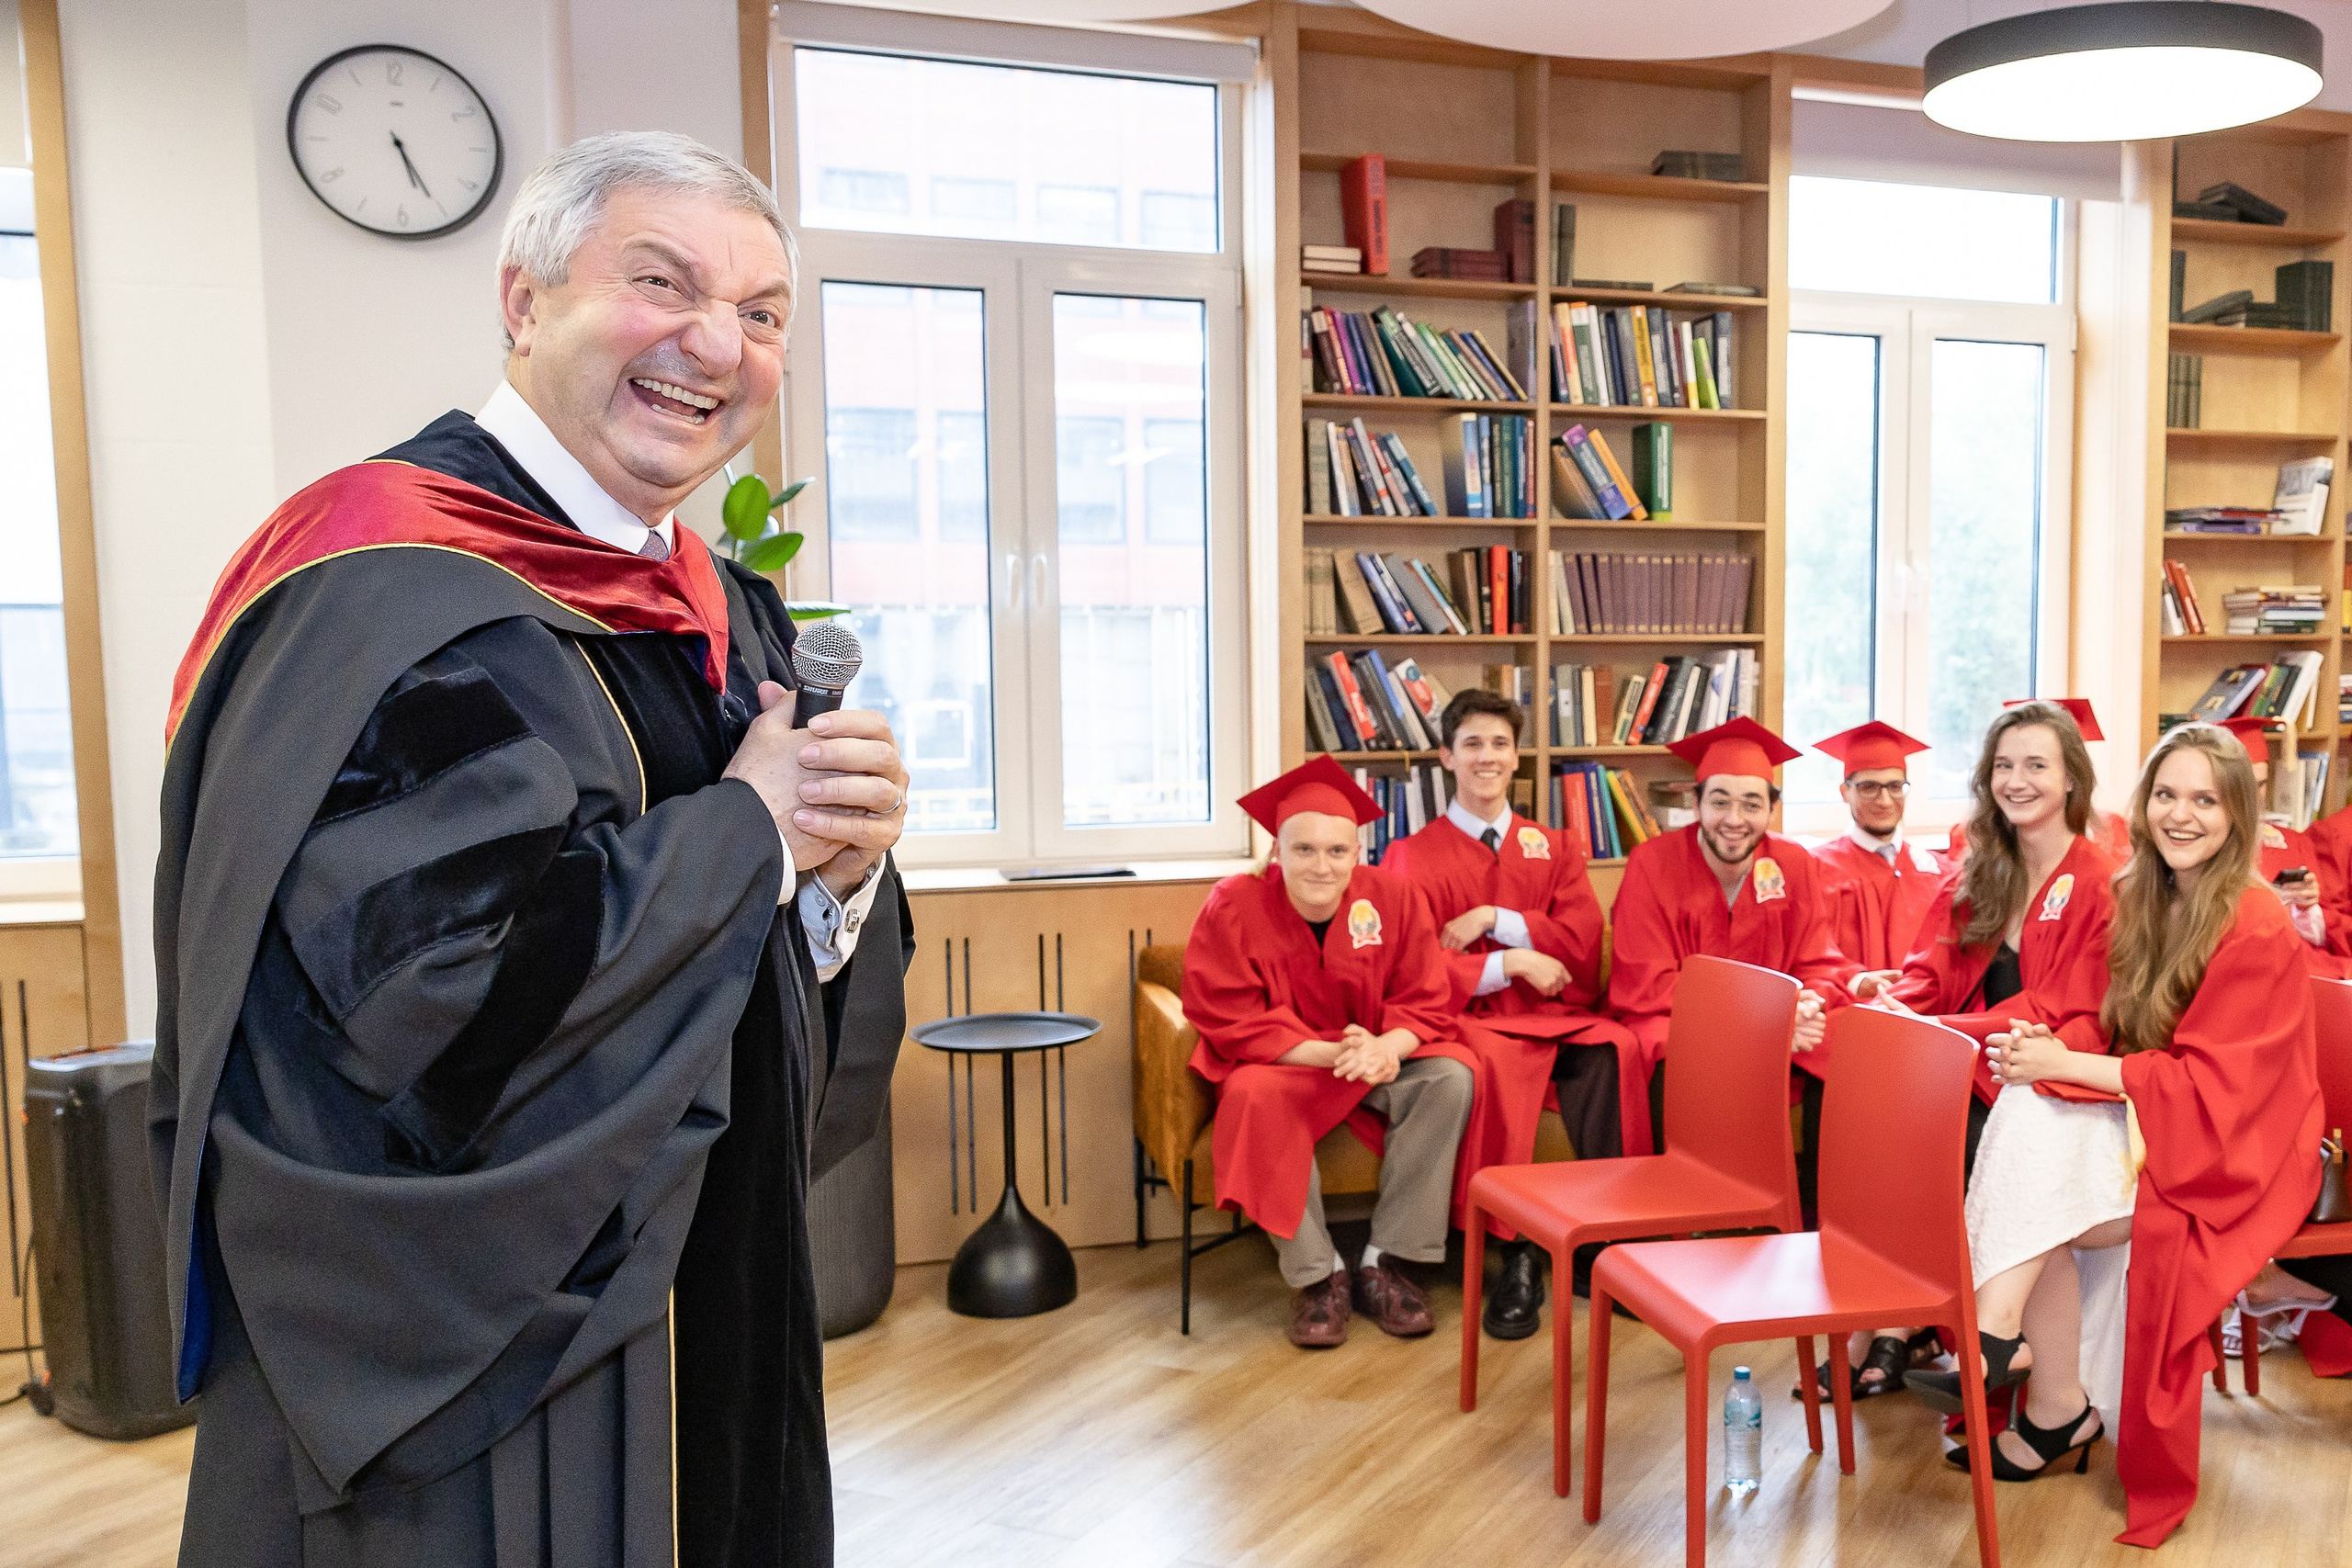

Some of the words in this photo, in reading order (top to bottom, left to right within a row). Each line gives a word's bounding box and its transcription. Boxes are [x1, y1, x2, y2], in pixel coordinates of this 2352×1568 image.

[386, 61, 404, 86] 12
[316, 94, 343, 116] 10
[451, 104, 480, 124] 2
[457, 175, 479, 193] 4
[396, 204, 409, 227] 6
[803, 684, 828, 694] SHURE
